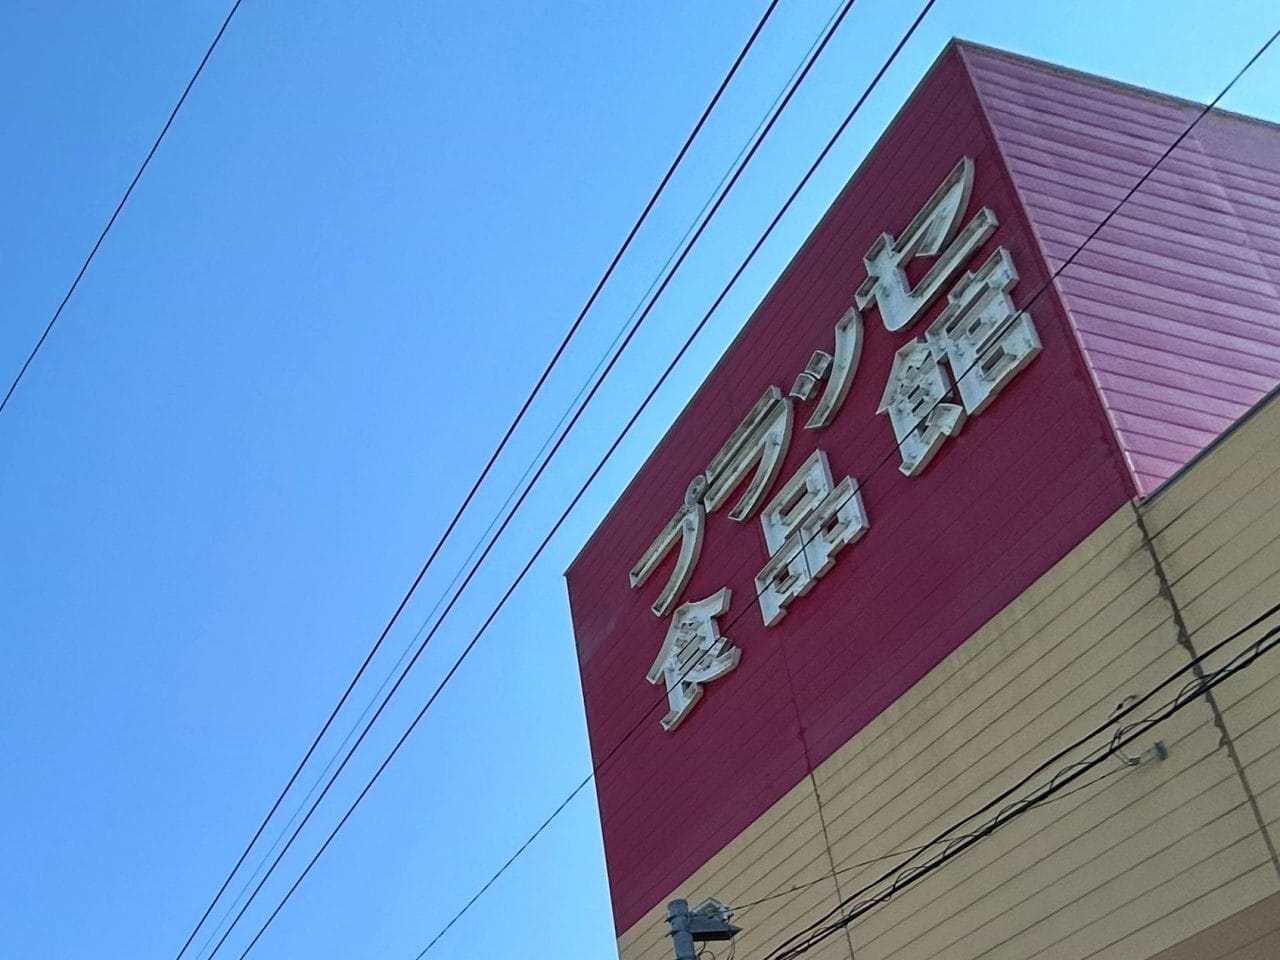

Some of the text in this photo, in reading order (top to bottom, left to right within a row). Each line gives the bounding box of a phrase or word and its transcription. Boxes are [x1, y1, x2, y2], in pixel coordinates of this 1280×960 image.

[628, 154, 1000, 617] プラッセ
[646, 246, 1043, 732] 食品館
